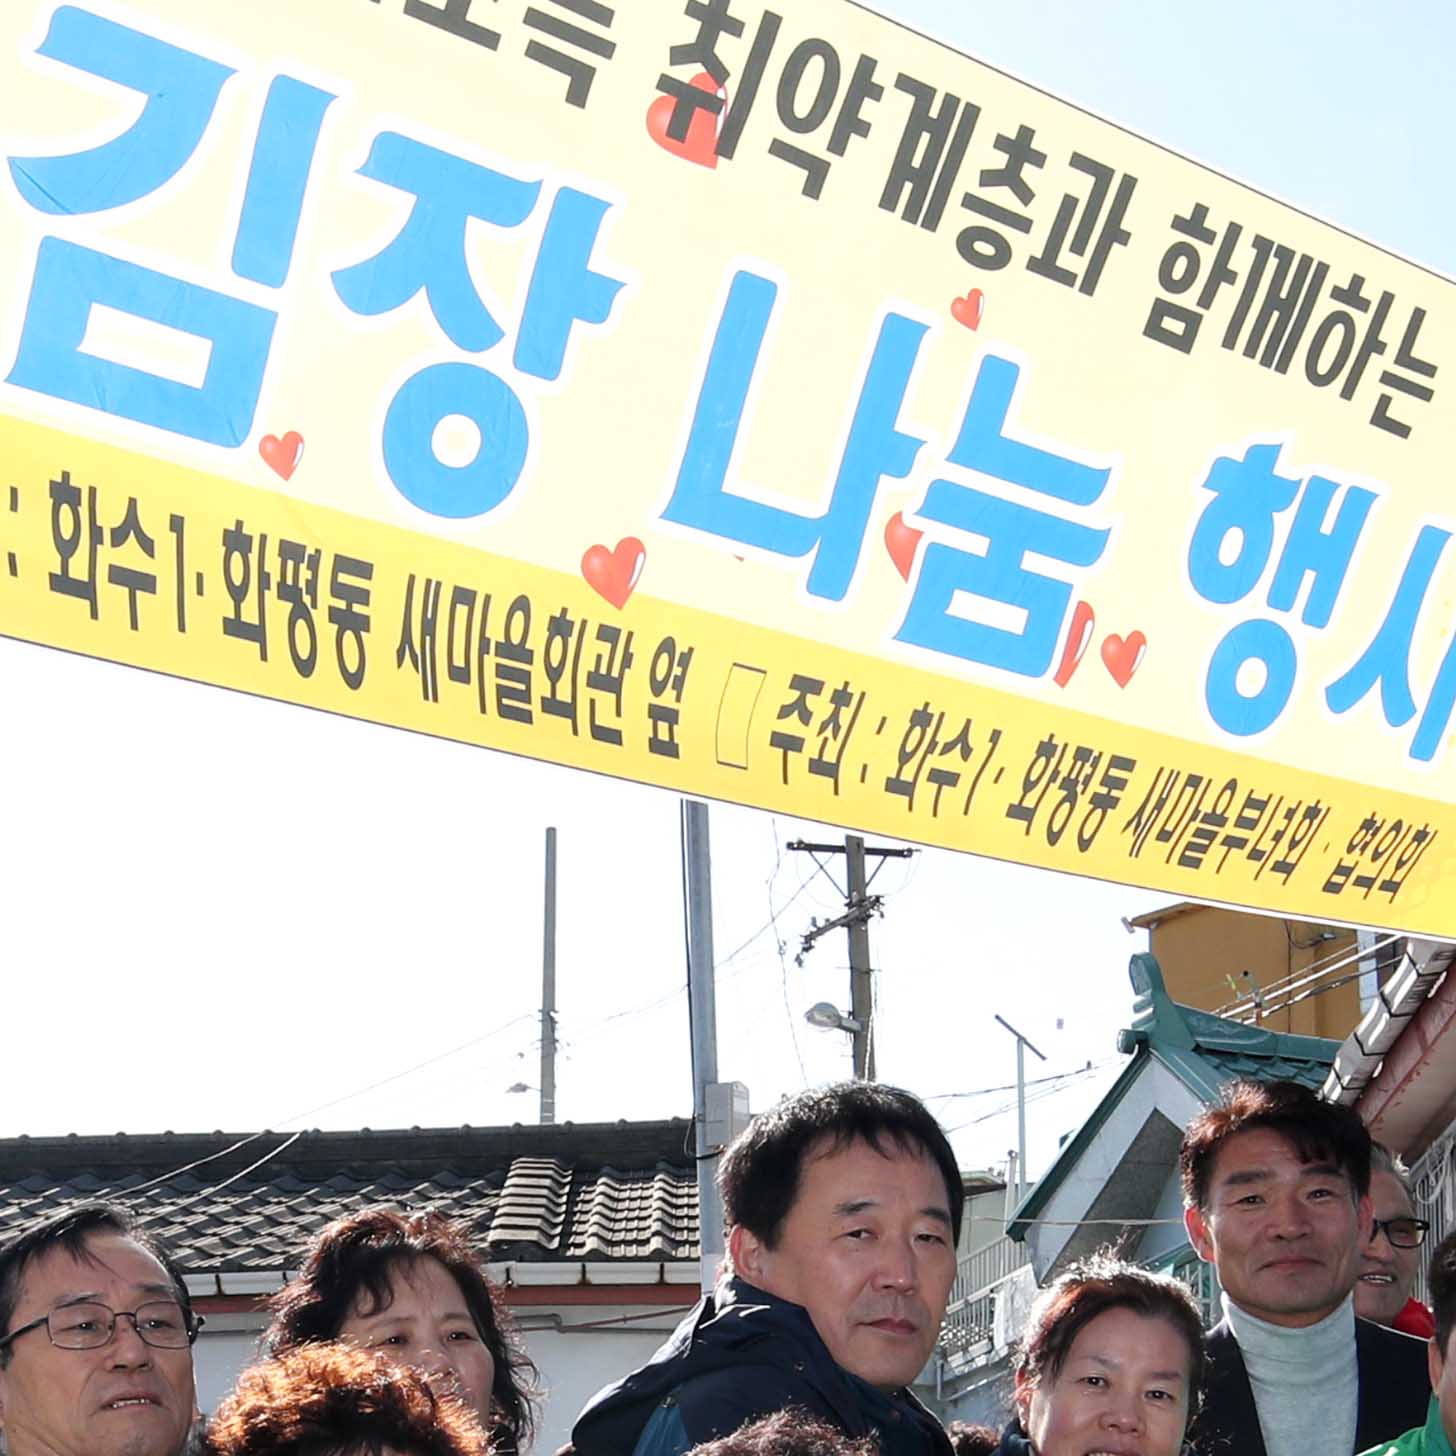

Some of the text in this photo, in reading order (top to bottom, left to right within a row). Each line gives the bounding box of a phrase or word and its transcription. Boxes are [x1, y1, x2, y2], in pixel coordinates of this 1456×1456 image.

[655, 0, 1138, 297] 취약계층과
[3, 4, 627, 519] 김장
[659, 269, 1113, 679] 나눔
[396, 572, 634, 747] 새마을회관
[648, 635, 695, 759] 옆
